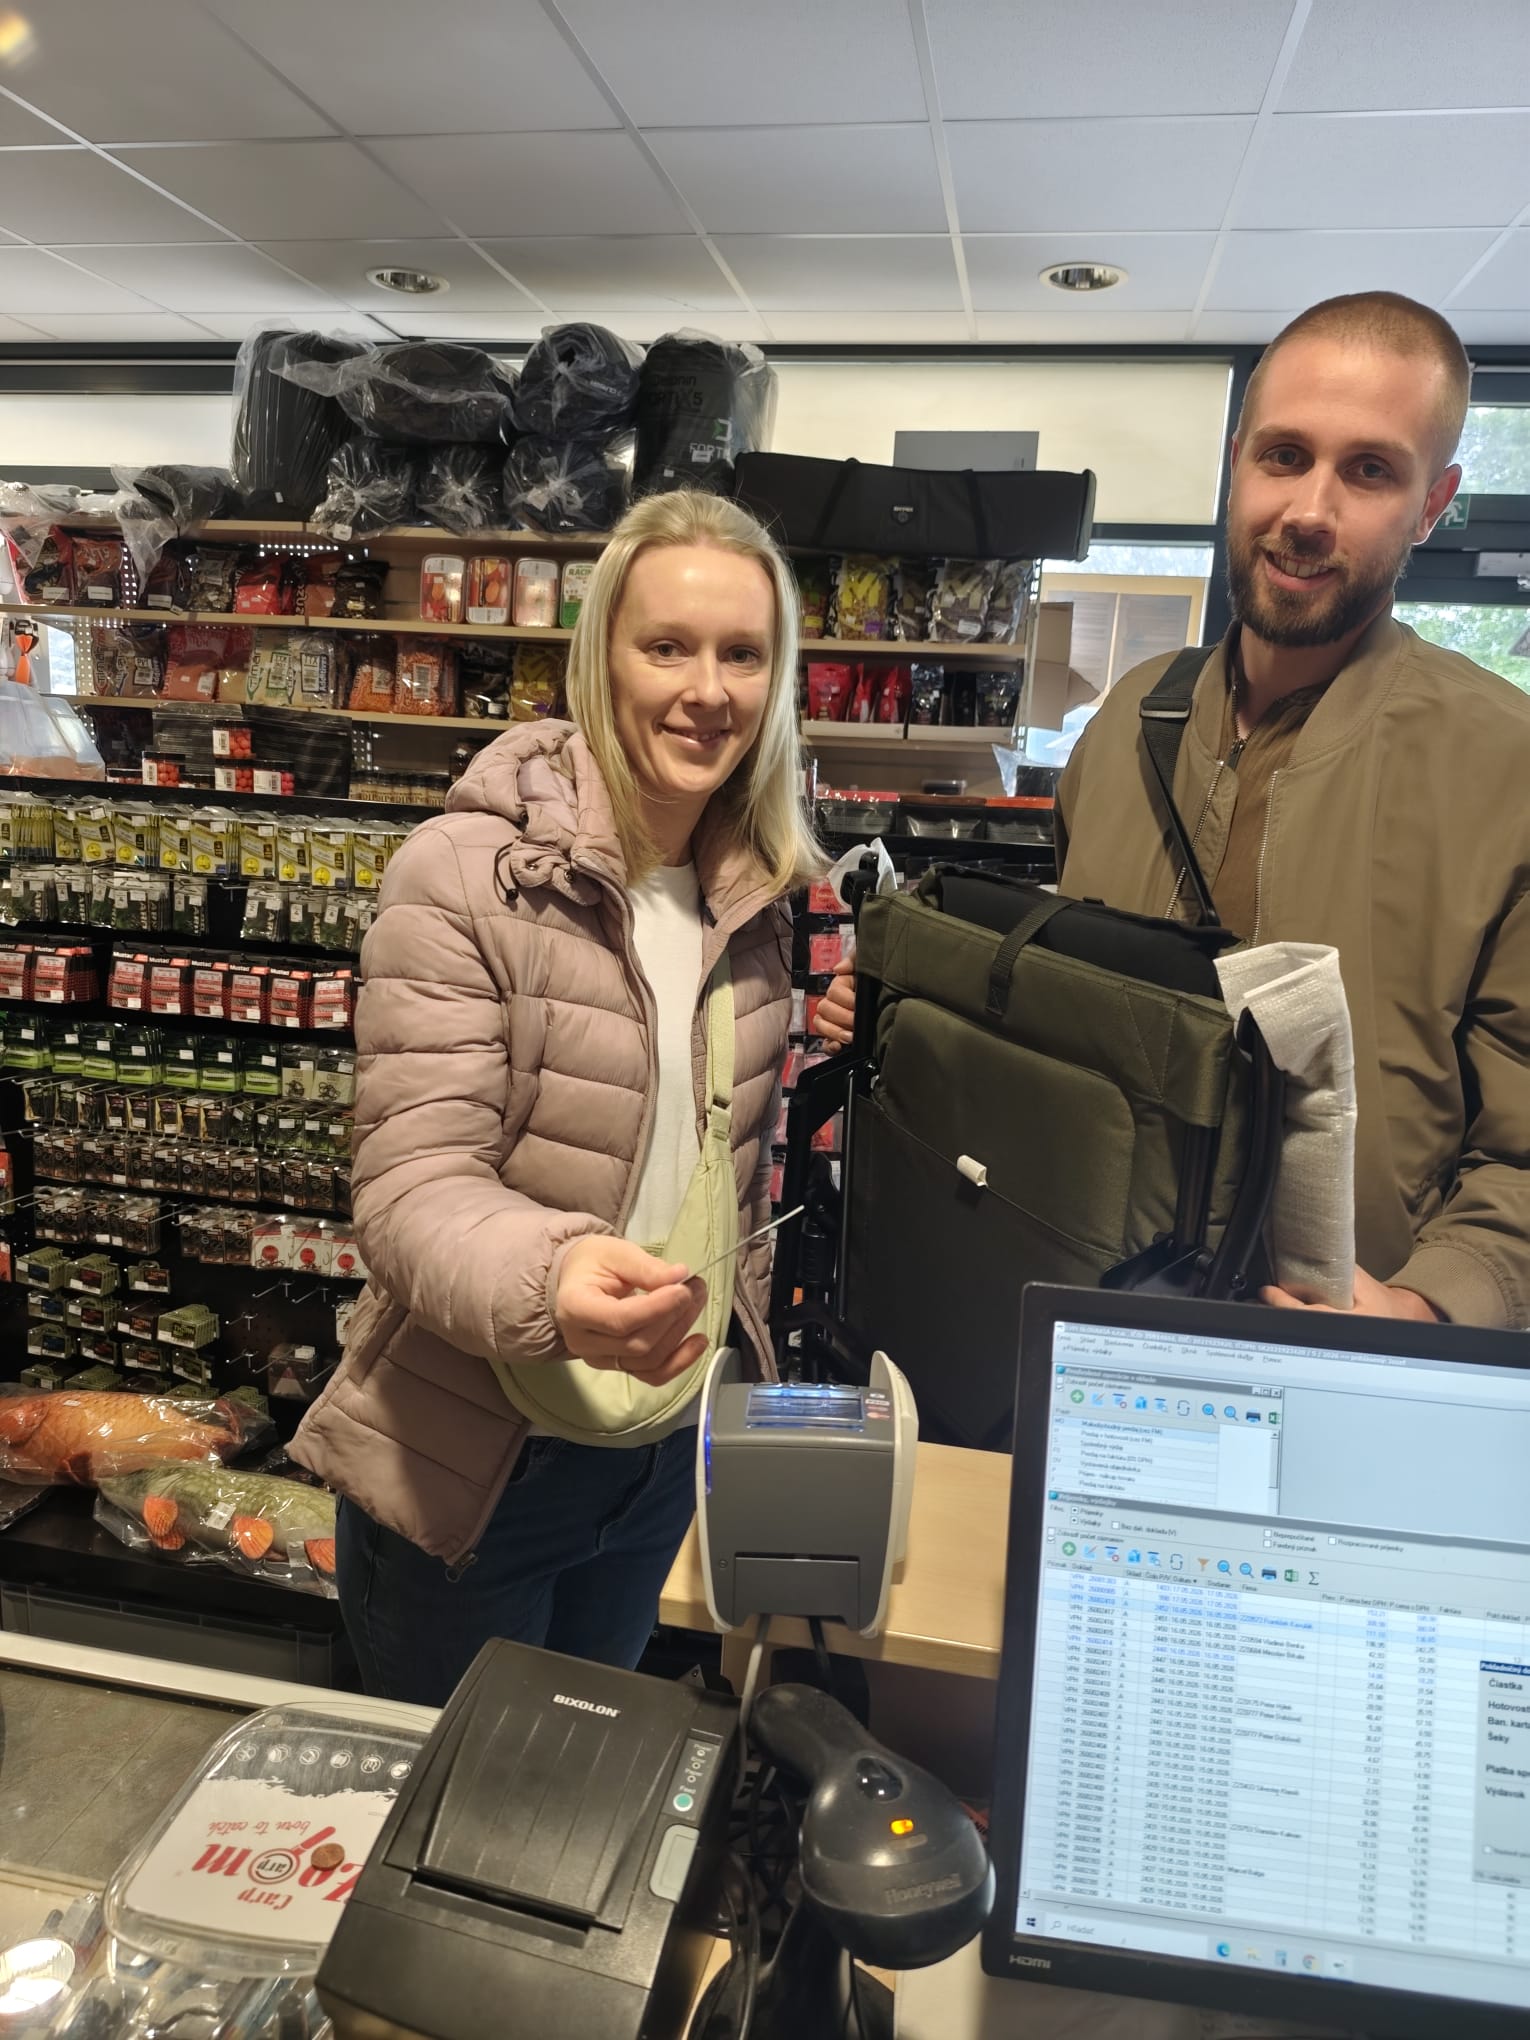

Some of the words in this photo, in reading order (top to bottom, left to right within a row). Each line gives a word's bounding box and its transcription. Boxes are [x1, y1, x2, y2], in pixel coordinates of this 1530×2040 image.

[1488, 1677, 1522, 1691] Čiastka
[552, 1693, 620, 1718] BIXOLON
[1488, 1716, 1508, 1727] Ban.
[254, 1821, 269, 1836] to
[237, 1888, 293, 1911] Carp
[1009, 1954, 1052, 1969] HDMI
